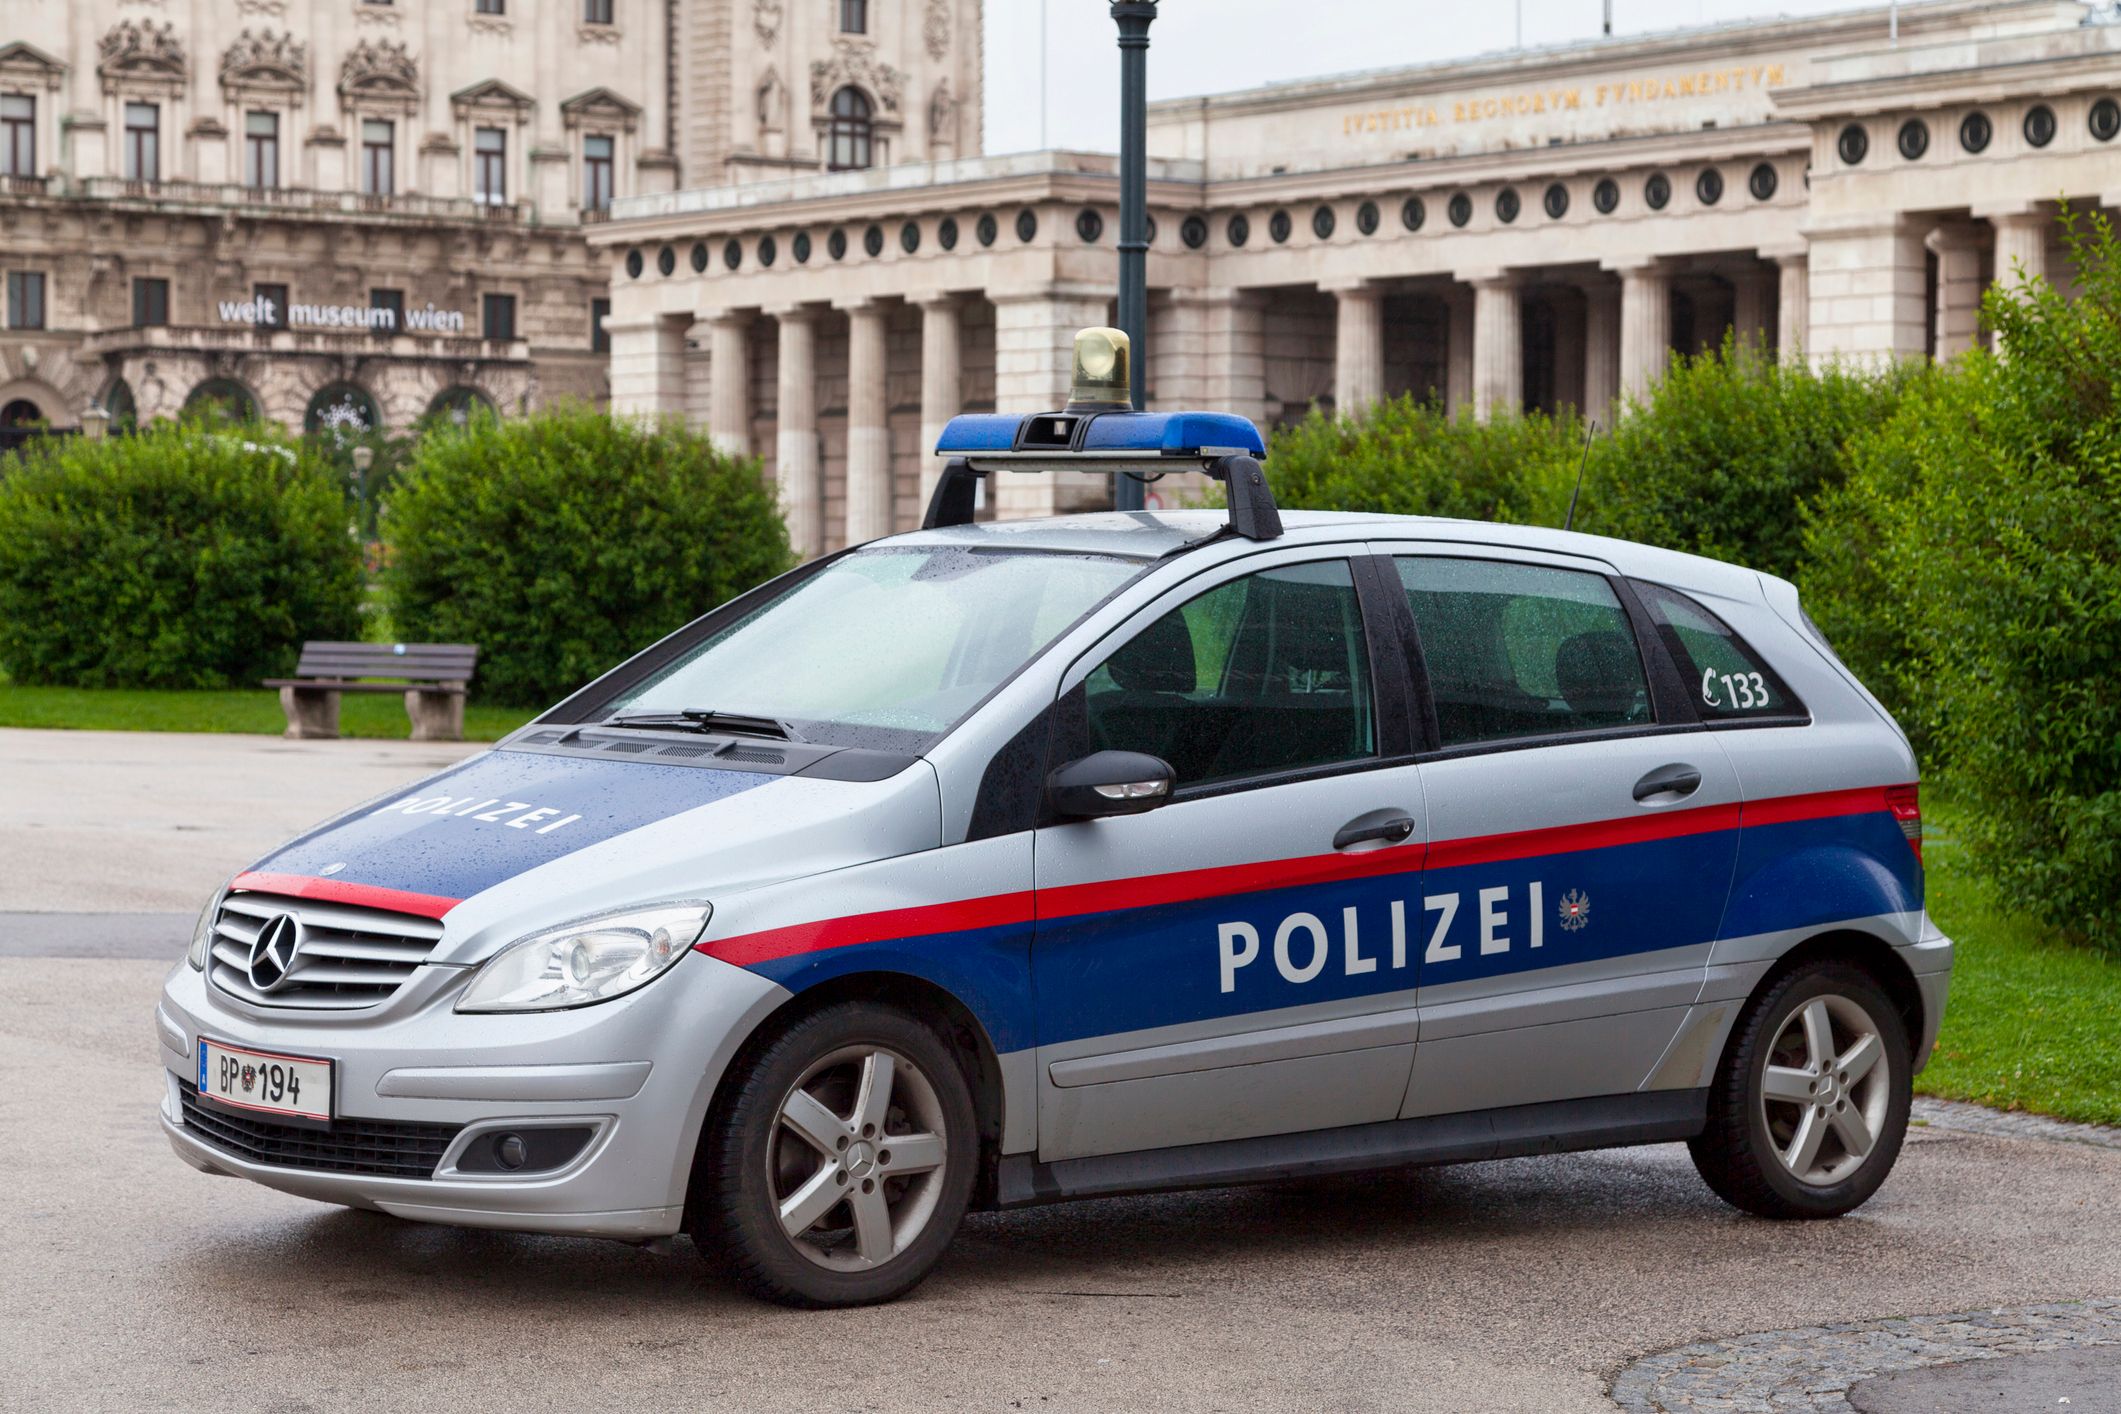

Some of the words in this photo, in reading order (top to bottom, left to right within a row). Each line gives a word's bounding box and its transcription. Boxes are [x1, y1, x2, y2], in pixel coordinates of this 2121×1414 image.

[219, 295, 276, 324] welt
[288, 303, 395, 328] museum
[405, 303, 464, 331] wien
[1720, 672, 1769, 708] 133
[370, 797, 582, 834] POLIZEI
[1218, 881, 1543, 993] POLIZEI
[220, 1055, 239, 1094] BP
[258, 1062, 300, 1105] 194
